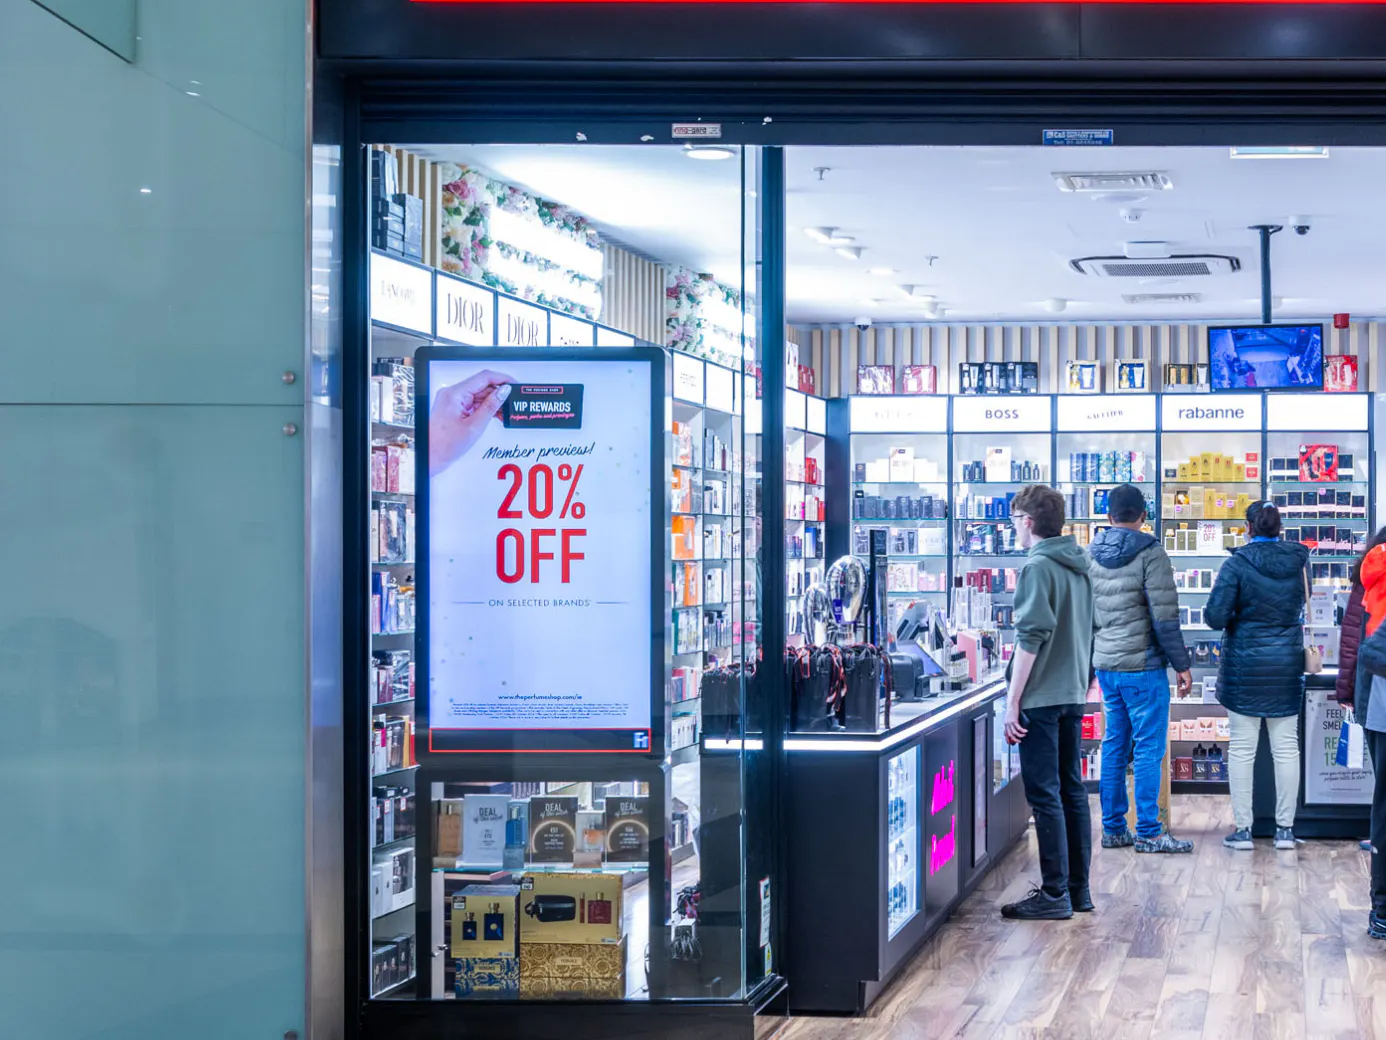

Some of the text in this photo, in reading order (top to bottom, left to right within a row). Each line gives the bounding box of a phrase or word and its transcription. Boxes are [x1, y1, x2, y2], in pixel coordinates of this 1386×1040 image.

[447, 293, 484, 334] DIOR
[507, 313, 539, 346] DIOR
[513, 401, 571, 412] VIP REWARDS
[985, 409, 1019, 420] BOSS
[1178, 407, 1245, 419] rabanne
[482, 441, 596, 462] Member preview!
[497, 463, 586, 519] 20%
[496, 528, 587, 584] OFF
[488, 599, 504, 607] ON
[507, 599, 550, 607] SELECTED
[1326, 709, 1344, 719] FEEL
[1322, 720, 1342, 731] SMEL
[479, 807, 497, 817] DEAL
[545, 803, 563, 812] DEAL
[620, 802, 638, 811] DEAL
